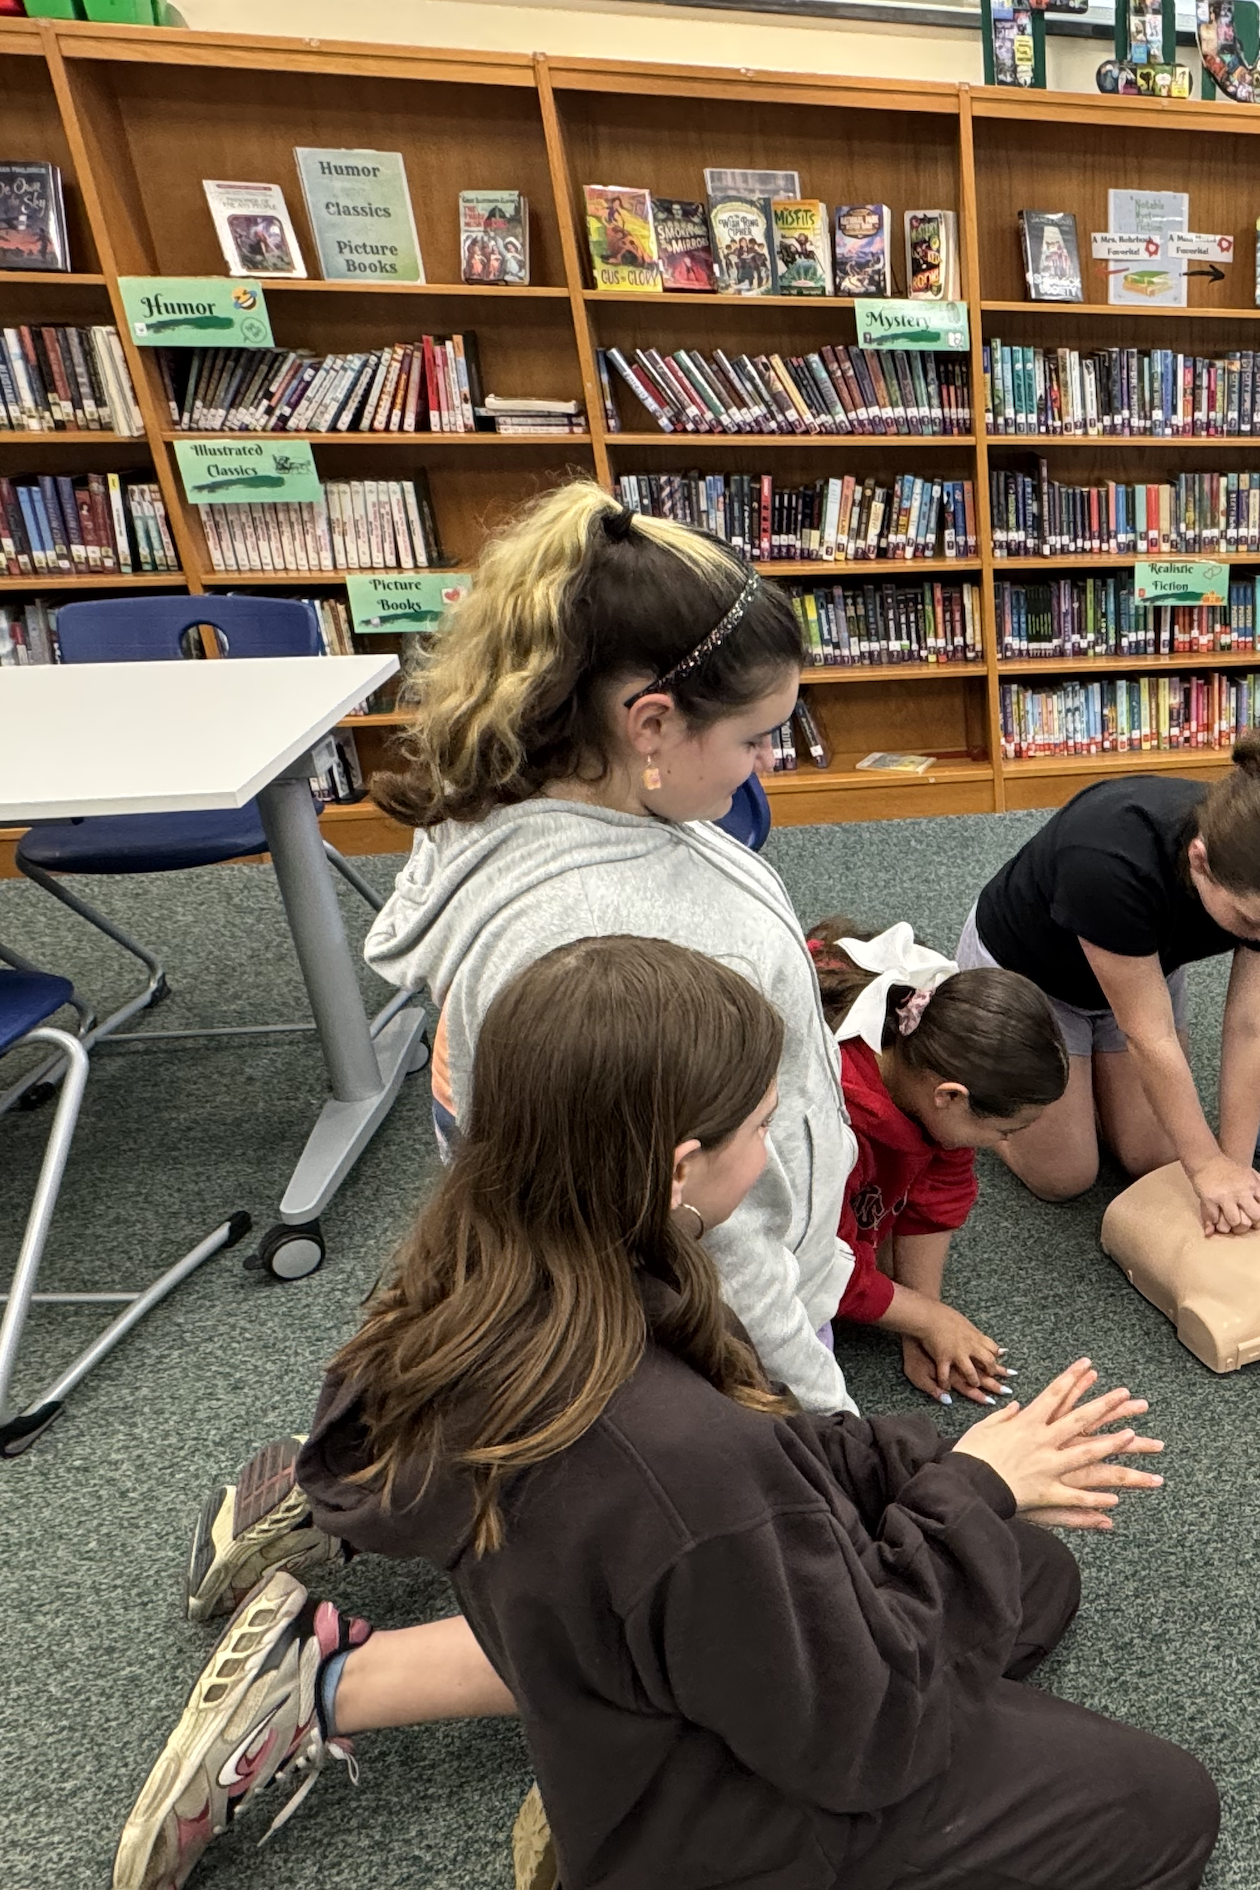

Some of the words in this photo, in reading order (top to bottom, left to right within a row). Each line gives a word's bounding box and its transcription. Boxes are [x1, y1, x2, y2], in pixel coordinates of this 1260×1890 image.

[318, 160, 380, 178] Humor
[325, 201, 392, 218] Classics
[336, 239, 399, 256] Picture
[344, 258, 398, 274] Books
[600, 268, 620, 285] GUS
[627, 269, 660, 288] GLORY
[140, 292, 217, 319] Humor
[865, 309, 932, 332] Mystery
[190, 443, 263, 457] Illustrated
[207, 463, 258, 478] Classics
[1148, 562, 1194, 575] Realistic
[368, 578, 422, 591] Picture
[1151, 580, 1189, 592] Fiction
[376, 598, 423, 613] Books
